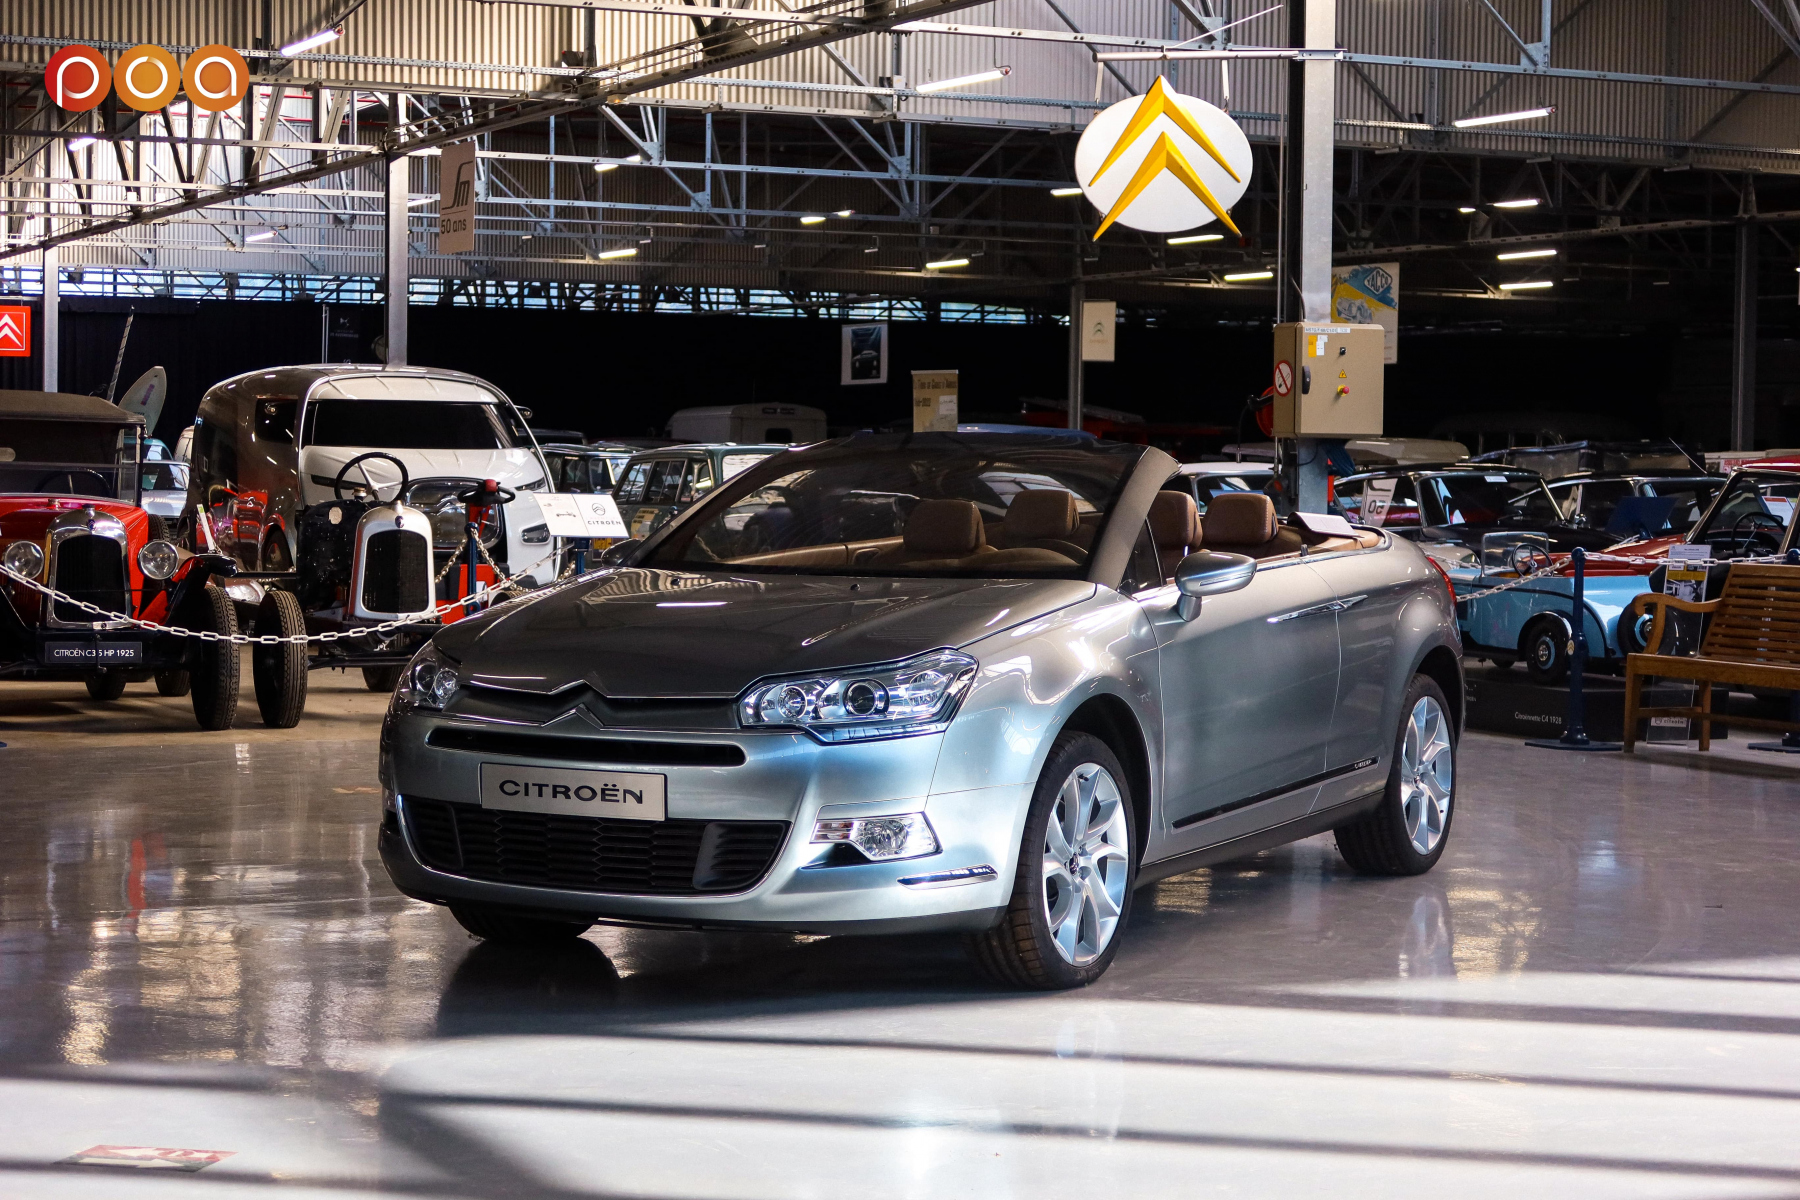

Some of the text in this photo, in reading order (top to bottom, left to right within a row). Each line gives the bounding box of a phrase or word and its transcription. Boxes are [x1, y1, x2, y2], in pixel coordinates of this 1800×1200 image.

[440, 218, 467, 235] 50 ans
[1366, 269, 1390, 293] YACCO
[53, 648, 135, 657] CITROËN C3 5 HP 1925
[498, 779, 643, 805] CITROËN
